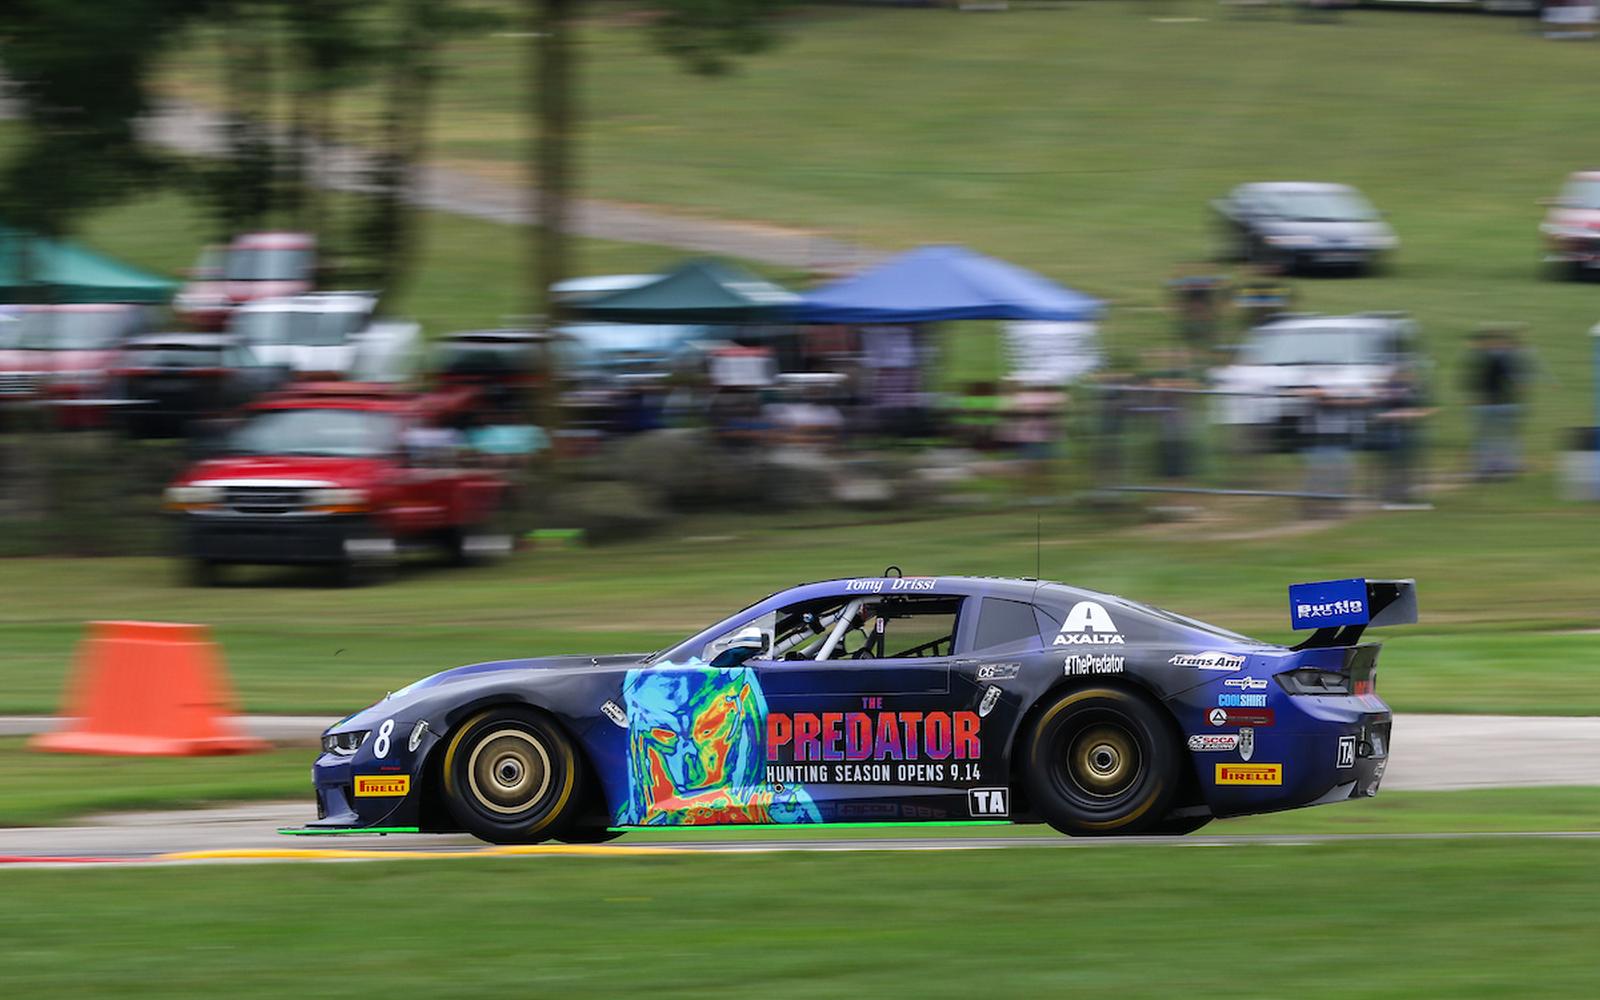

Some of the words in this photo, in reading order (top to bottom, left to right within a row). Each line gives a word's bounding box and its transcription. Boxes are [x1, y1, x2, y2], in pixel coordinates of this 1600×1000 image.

[845, 579, 883, 593] Tomy
[891, 579, 936, 590] Drissi
[1052, 634, 1125, 645] AXALTA
[1064, 653, 1125, 676] #ThePredator
[1173, 656, 1213, 666] Trans
[1214, 656, 1241, 668] Am
[862, 697, 883, 710] THE
[1218, 694, 1267, 707] COOLSHIRT
[373, 719, 395, 759] 8
[766, 711, 982, 762] PREDATOR
[1203, 736, 1235, 744] SCCA
[1340, 741, 1353, 764] TA
[766, 765, 828, 783] HUNTING
[835, 764, 891, 782] SEASON
[898, 764, 944, 782] OPENS
[950, 763, 981, 781] 9.14
[1221, 767, 1277, 781] PIRELLI
[359, 780, 405, 792] PIRELLI
[973, 791, 1005, 814] TA
